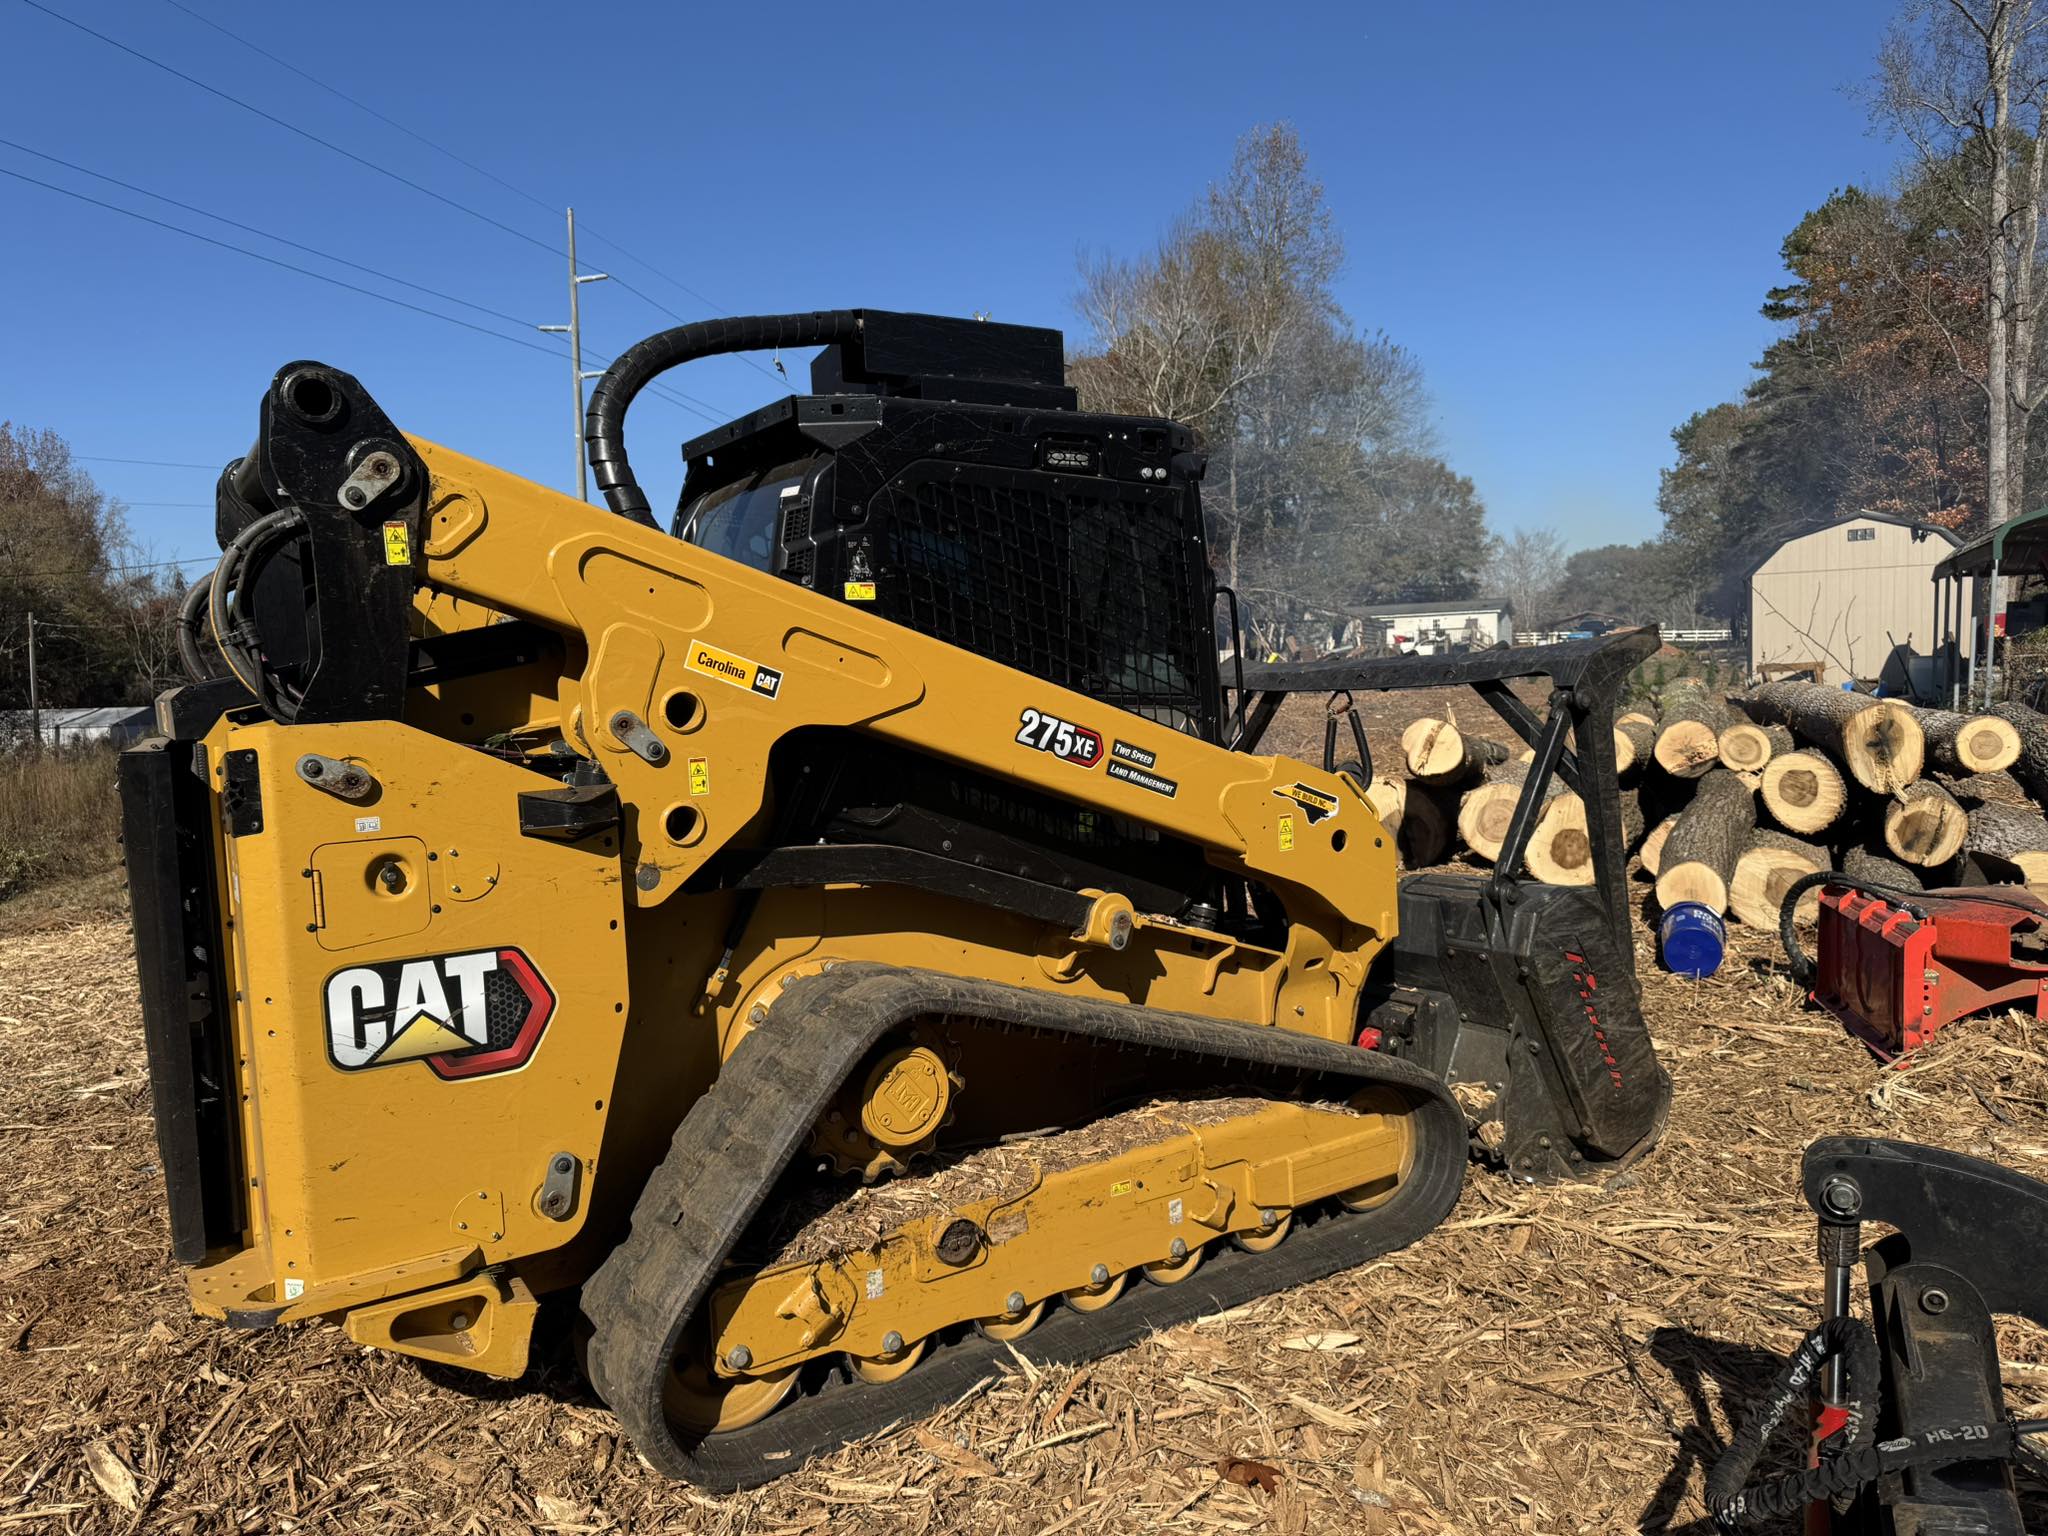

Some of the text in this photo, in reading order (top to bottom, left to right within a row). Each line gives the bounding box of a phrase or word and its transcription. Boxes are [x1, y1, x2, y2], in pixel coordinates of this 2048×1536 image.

[697, 651, 778, 691] Carolina CAT
[1291, 788, 1302, 799] WE
[1302, 793, 1318, 805] BUILD
[328, 951, 498, 1067] CAT
